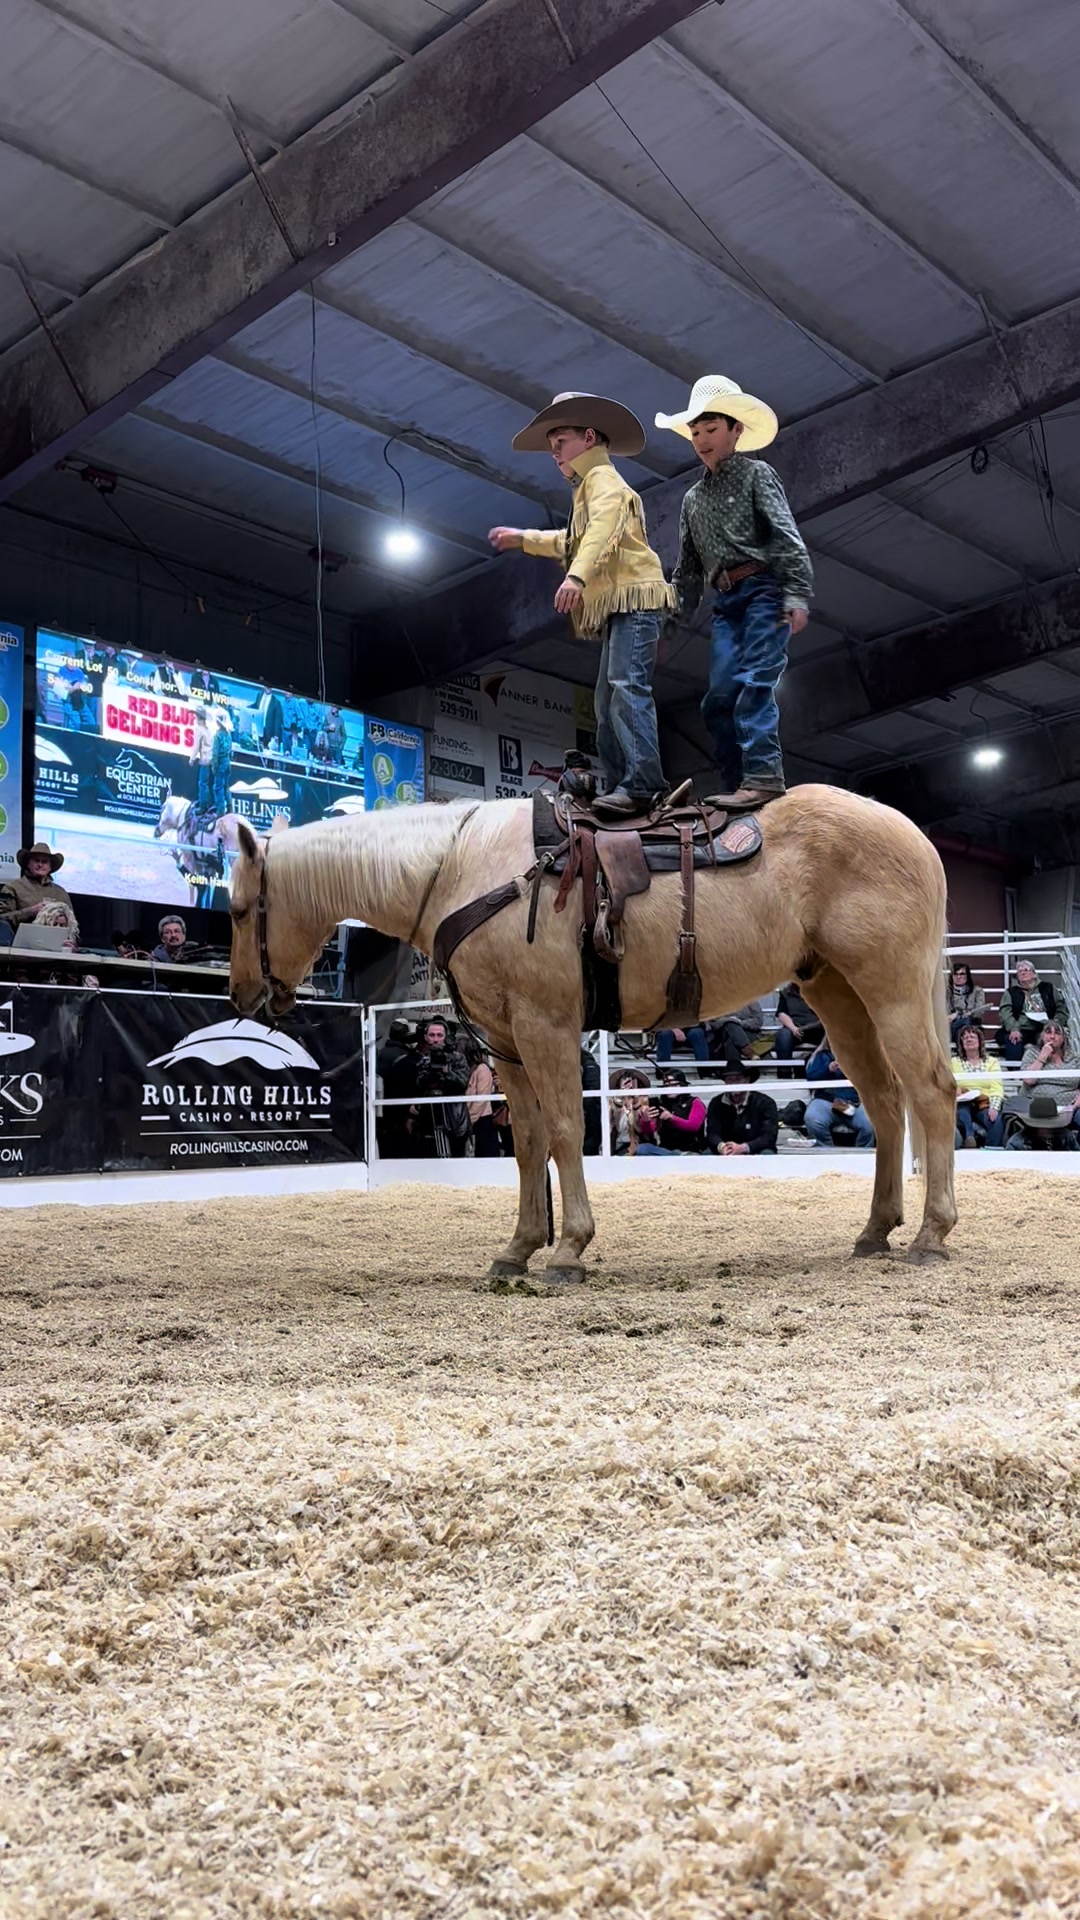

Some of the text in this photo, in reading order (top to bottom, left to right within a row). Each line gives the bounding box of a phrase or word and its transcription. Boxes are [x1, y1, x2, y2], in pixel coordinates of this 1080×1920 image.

[86, 660, 103, 674] Lot
[128, 695, 158, 718] RED
[440, 700, 478, 722] 529-9711
[107, 704, 181, 745] GELDING
[433, 734, 468, 752] FUNDING
[39, 767, 79, 785] HILLS
[106, 767, 172, 788] EQUESTRIAN
[118, 782, 160, 798] CENTER
[252, 801, 291, 823] LINKS
[185, 872, 208, 885] Keith
[142, 1084, 331, 1106] ROLLING HILLS
[179, 1111, 302, 1123] CASINO RESORT
[170, 1140, 309, 1155] ROLLINGHILLSCASINO.COM
